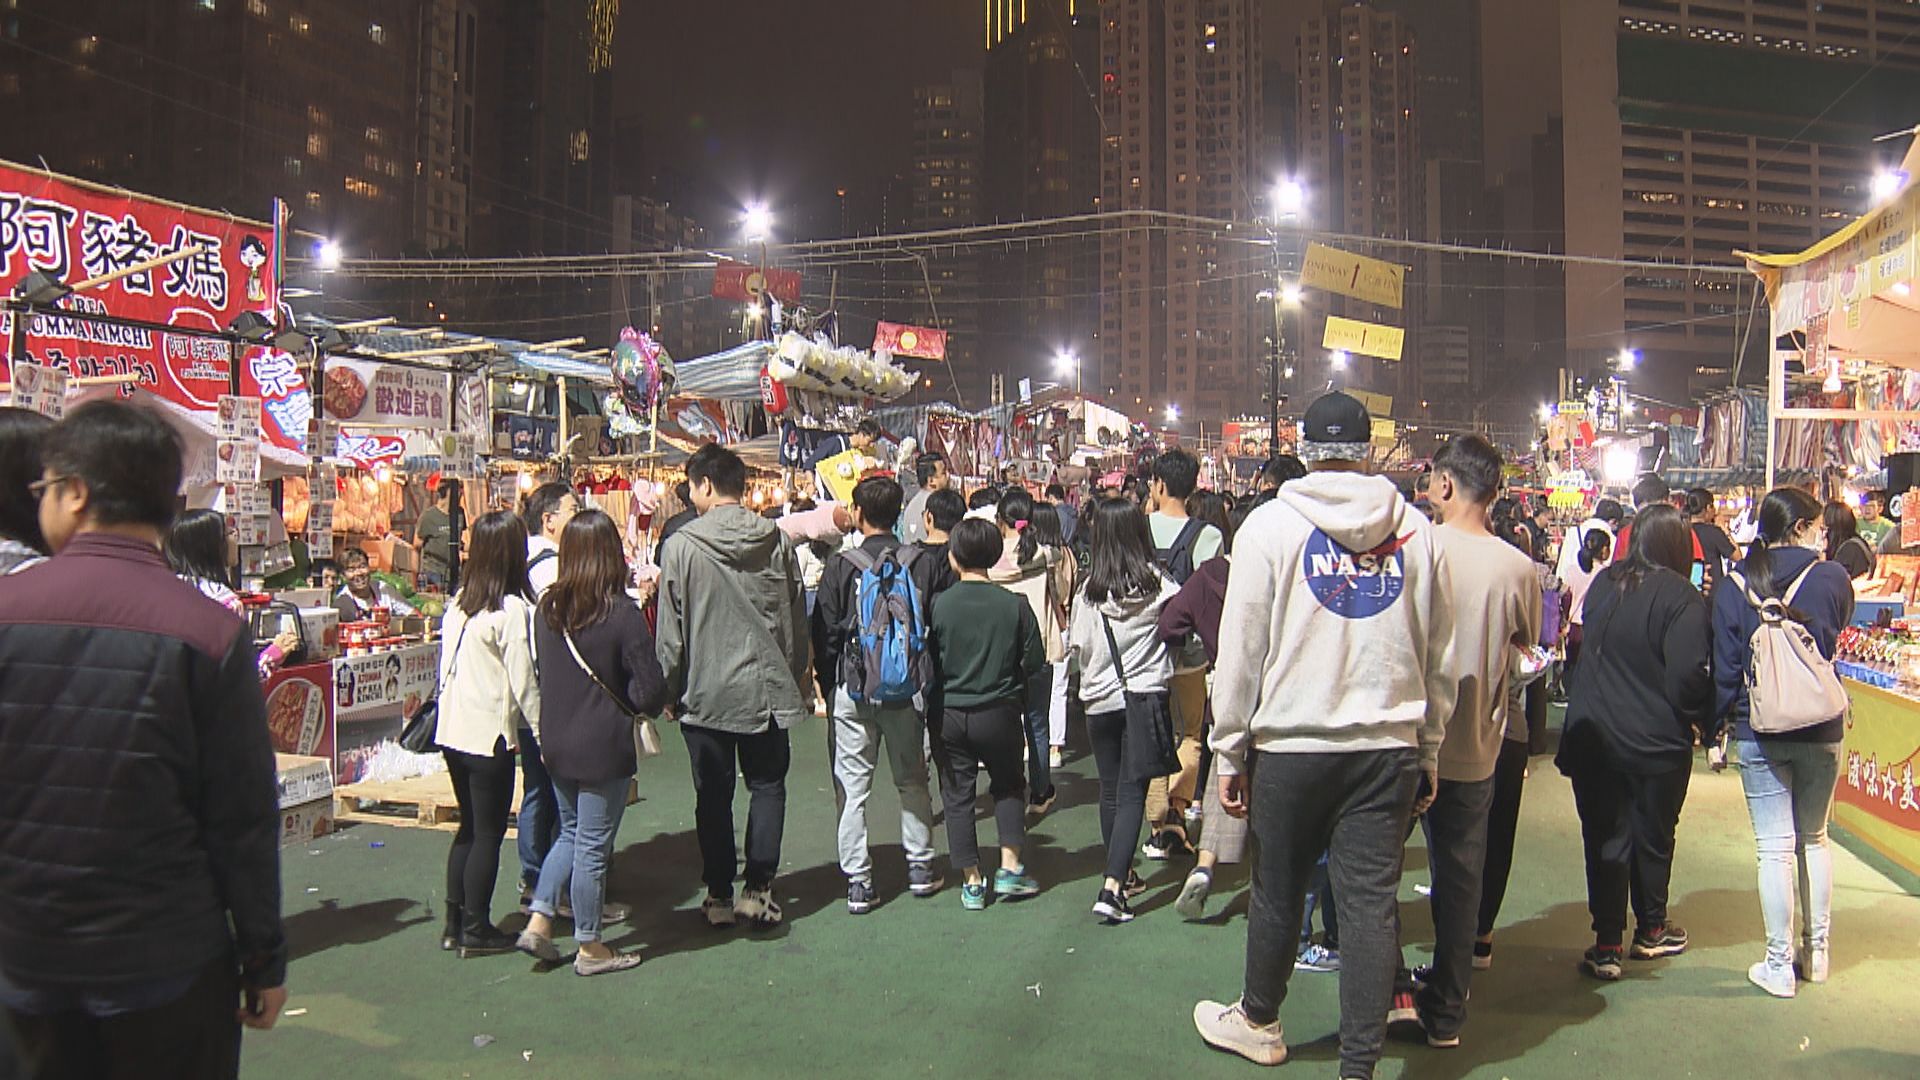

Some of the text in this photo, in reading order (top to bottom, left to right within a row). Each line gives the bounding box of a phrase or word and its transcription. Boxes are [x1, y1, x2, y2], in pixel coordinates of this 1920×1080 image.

[0, 194, 227, 306] 阿豬媽
[2, 312, 152, 348] AUMMA KIMCHI
[375, 385, 443, 419] 歡迎試食
[1310, 552, 1402, 577] NASA
